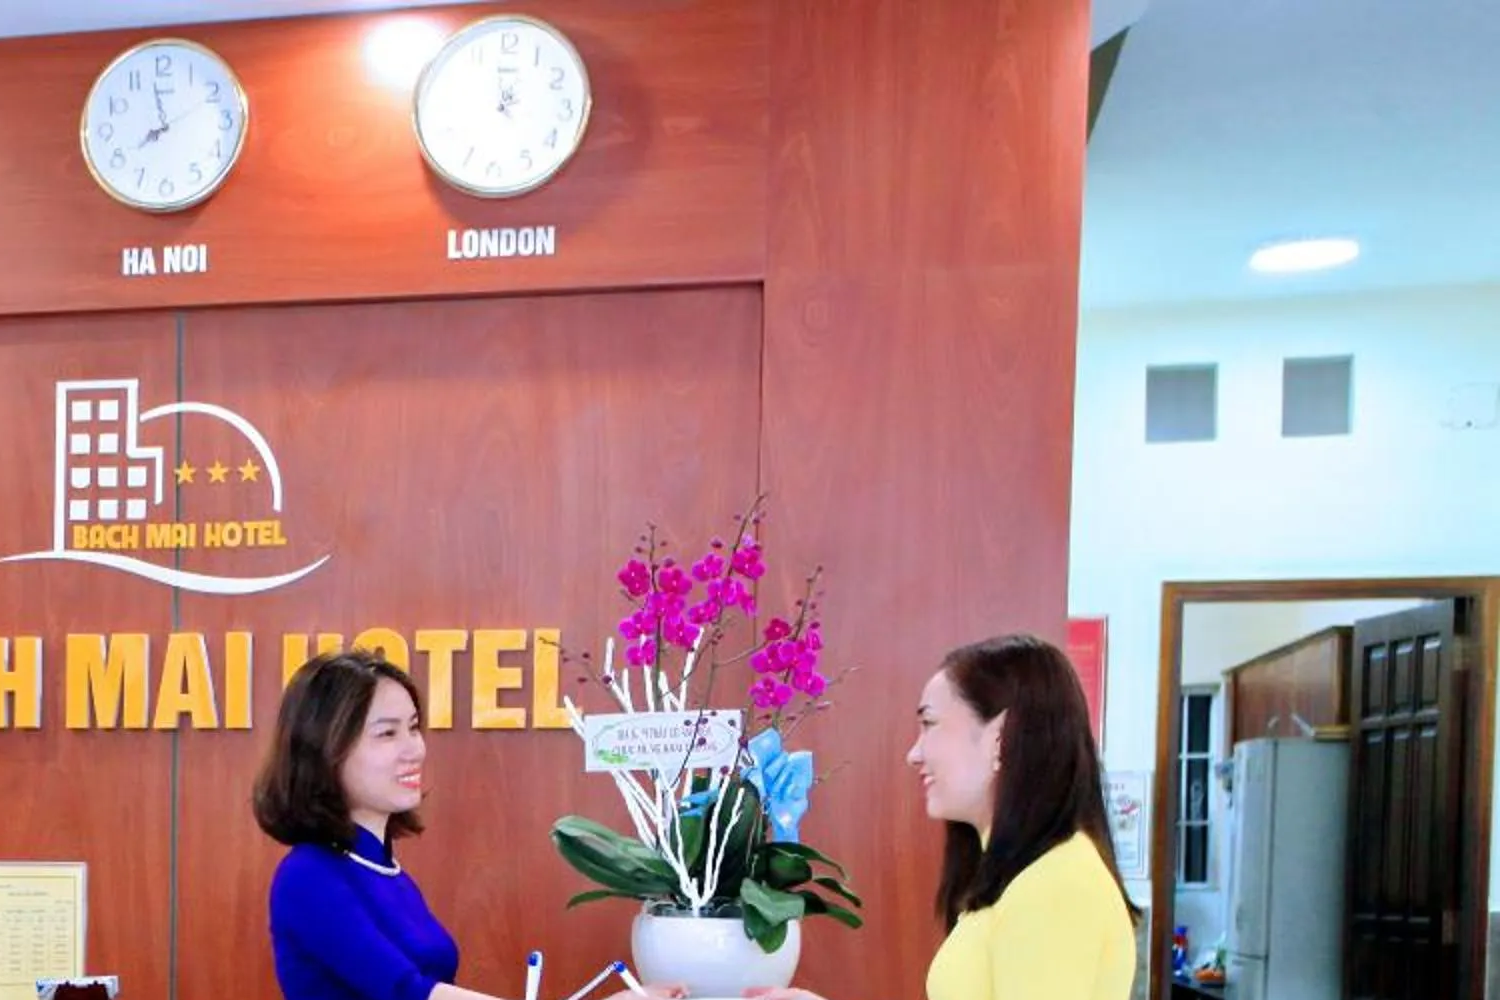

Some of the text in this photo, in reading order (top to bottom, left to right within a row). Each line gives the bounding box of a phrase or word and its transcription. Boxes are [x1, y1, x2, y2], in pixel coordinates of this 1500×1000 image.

[155, 55, 173, 77] 12
[204, 82, 221, 104] 2
[218, 109, 233, 131] 3
[447, 226, 556, 259] LONDON
[122, 244, 208, 276] HA NOI
[72, 520, 287, 549] BACH MAI HOTEL
[65, 631, 254, 730] MAI
[282, 628, 582, 729] TEL
